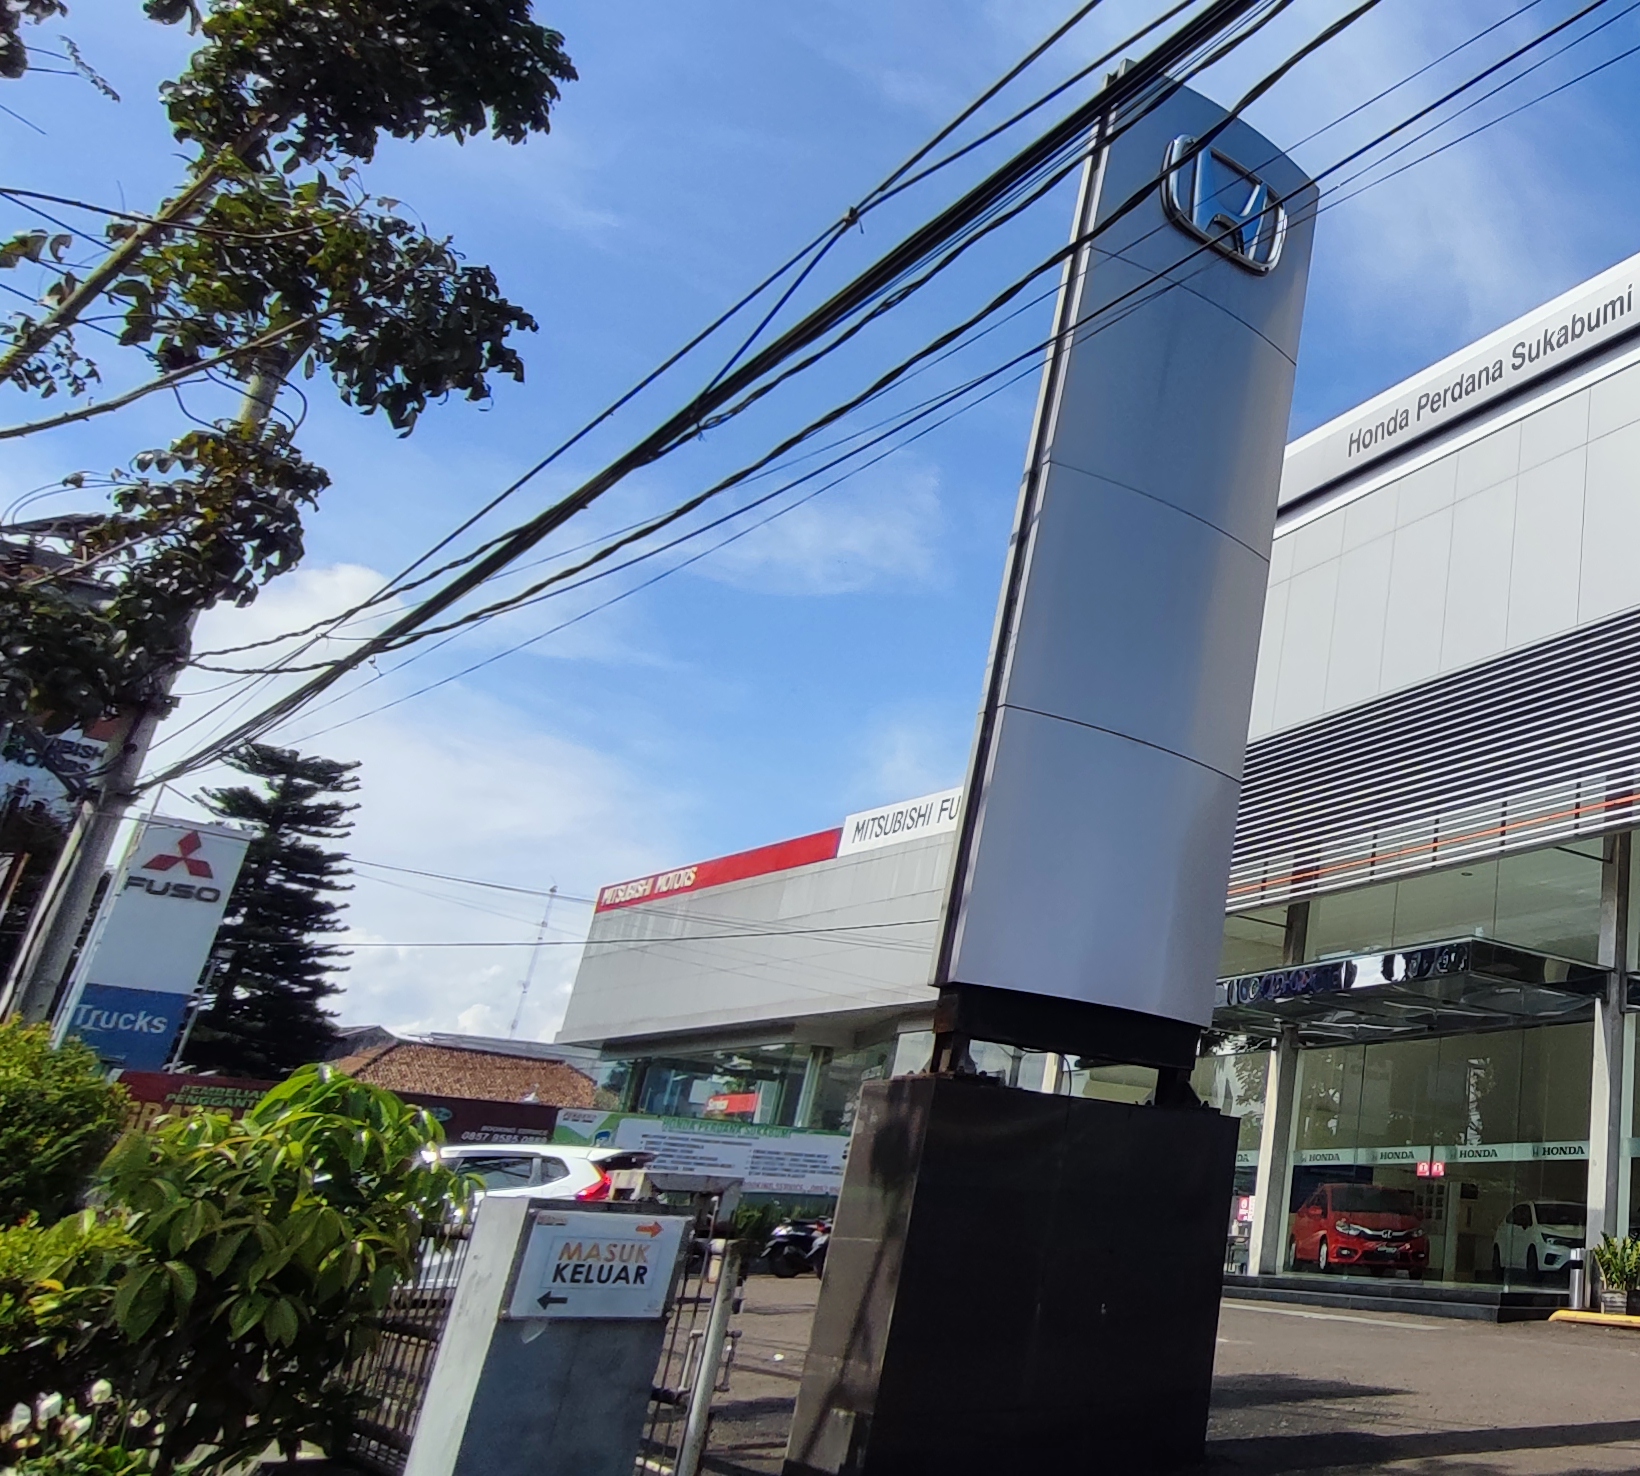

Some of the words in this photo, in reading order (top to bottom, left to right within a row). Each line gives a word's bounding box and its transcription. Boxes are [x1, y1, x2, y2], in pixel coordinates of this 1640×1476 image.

[1348, 407, 1409, 458] Honda
[1416, 358, 1503, 422] Perdana
[1511, 283, 1634, 371] Sukabumi
[852, 802, 934, 844] MITSUBISHI
[124, 875, 221, 903] FUSO
[600, 877, 655, 907] MITSUBISHI
[654, 866, 698, 894] MOTORS
[75, 1004, 168, 1034] Trucks
[1308, 1152, 1341, 1162] HONDA
[1379, 1150, 1415, 1160] HONDA
[1459, 1149, 1498, 1159] HONDA
[1541, 1146, 1585, 1156] HONDA
[558, 1242, 650, 1263] MASUK
[552, 1263, 648, 1285] KELUAR
